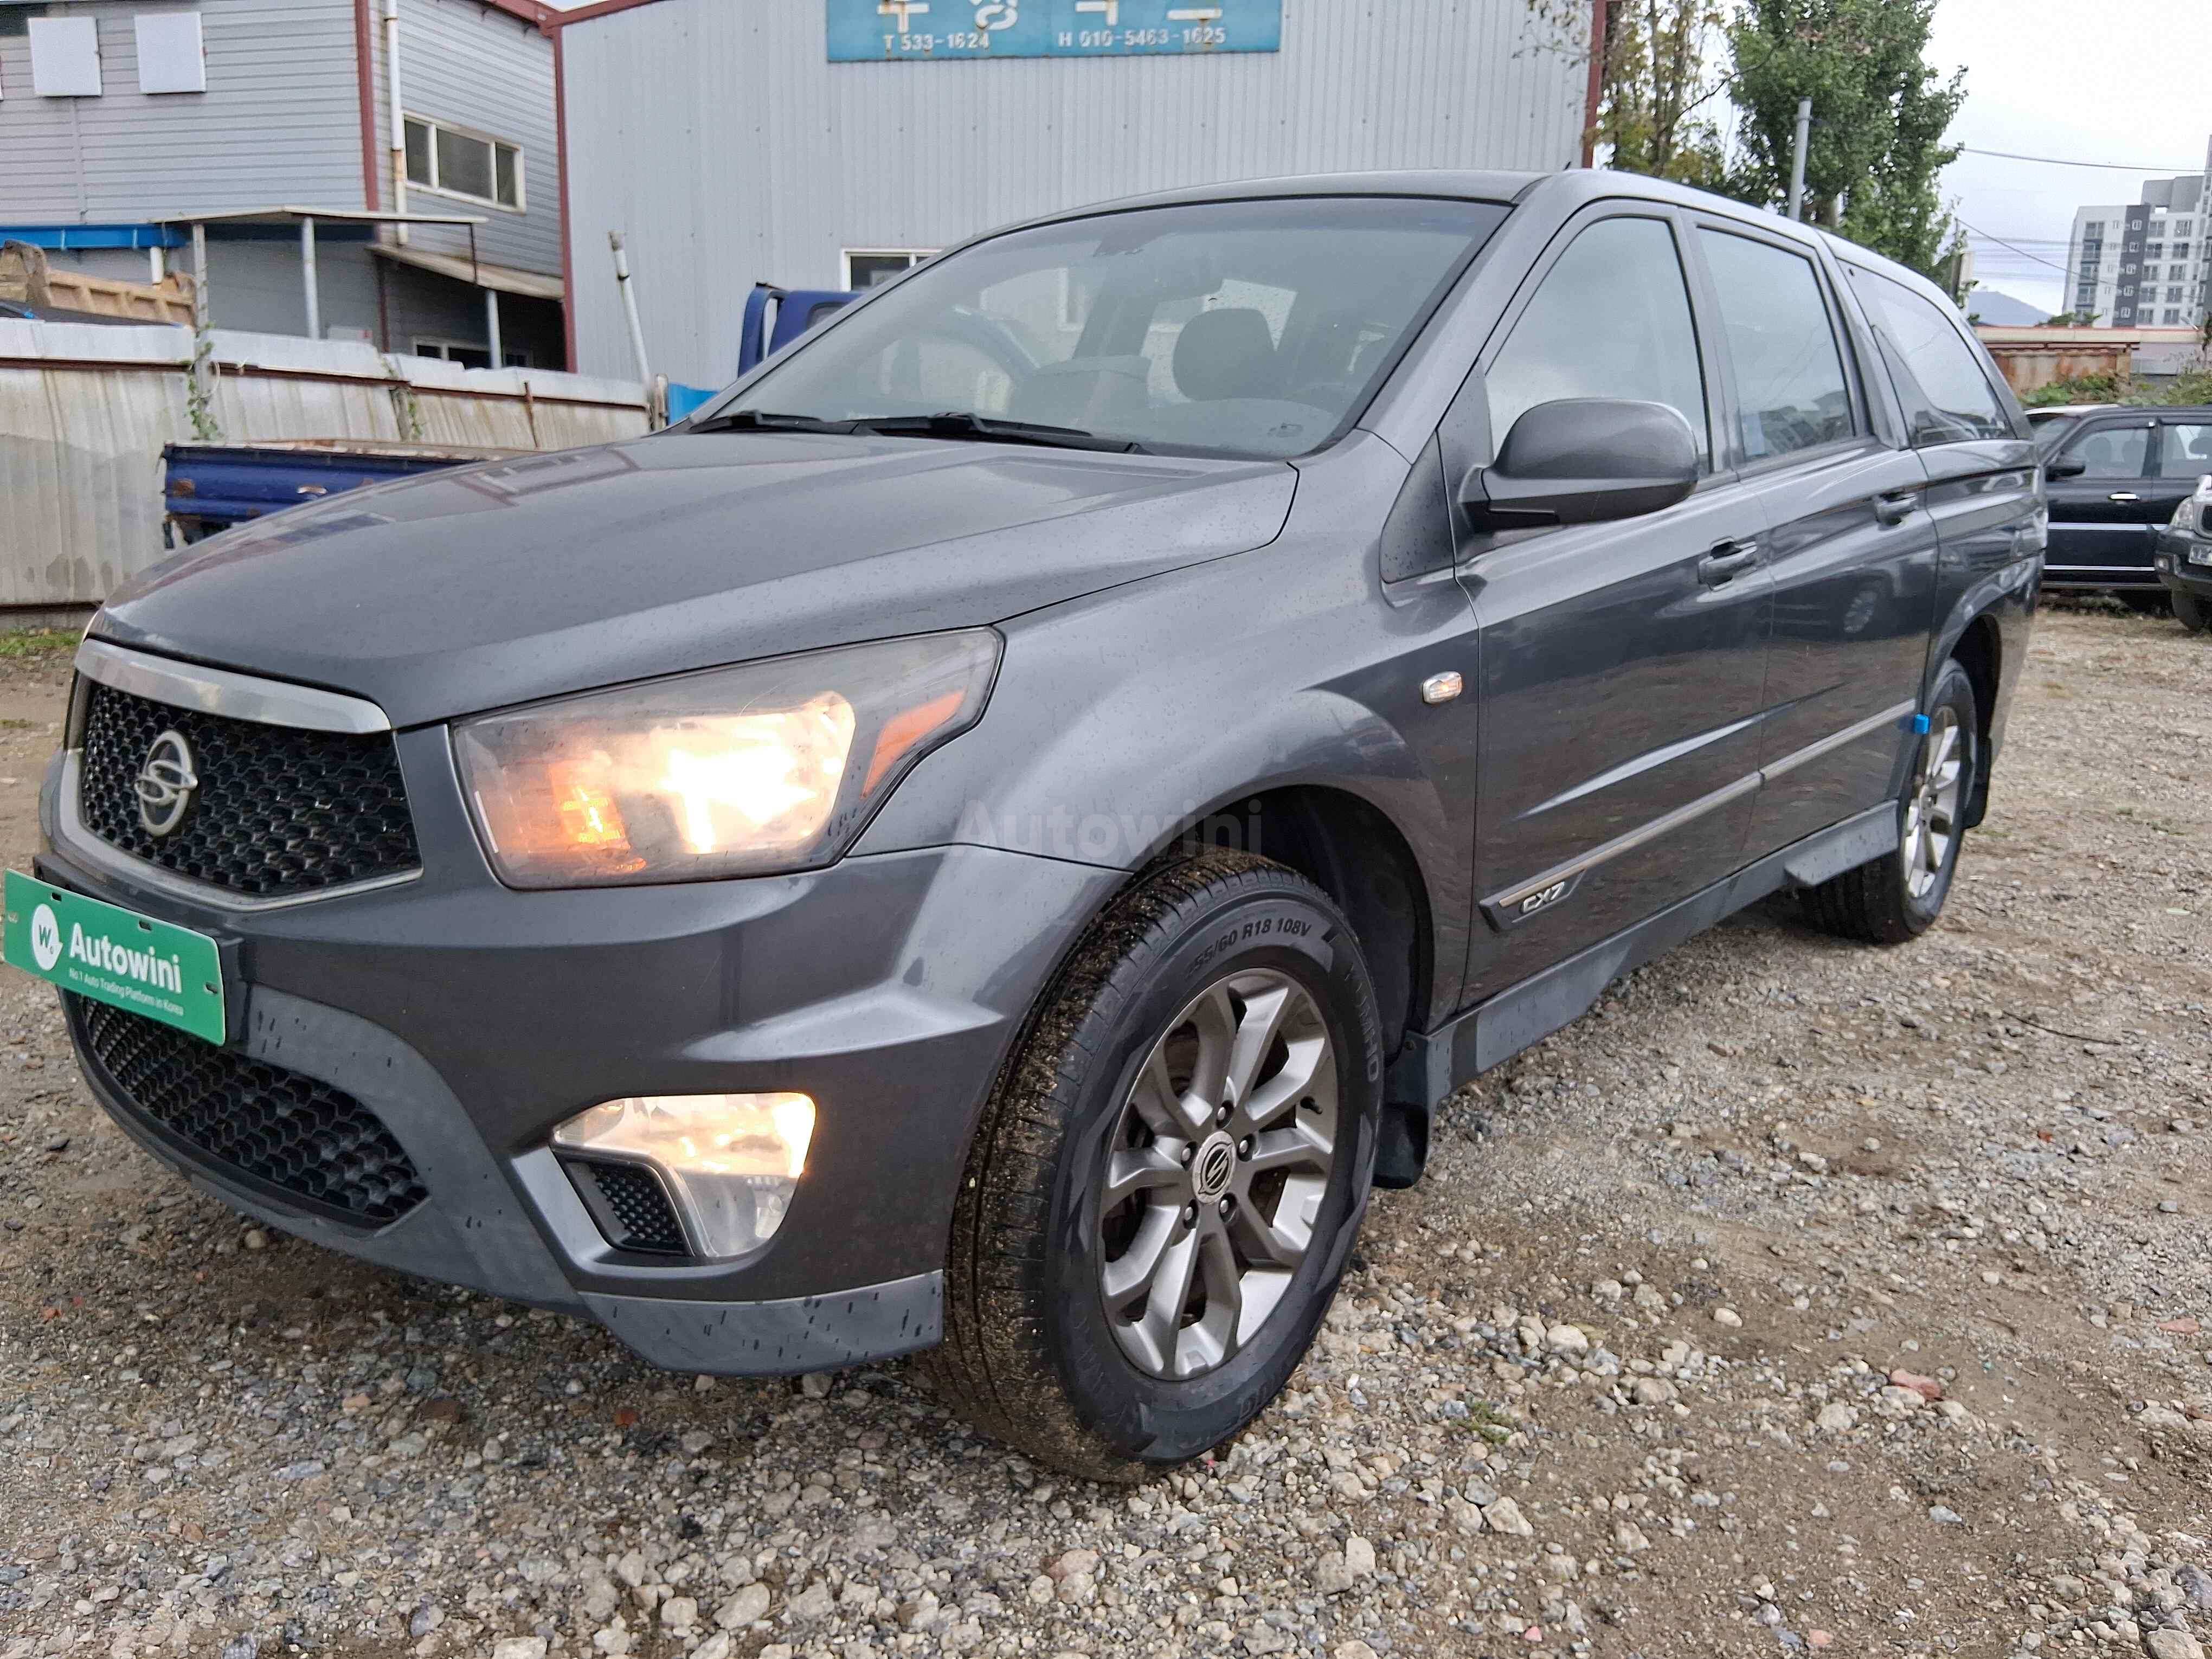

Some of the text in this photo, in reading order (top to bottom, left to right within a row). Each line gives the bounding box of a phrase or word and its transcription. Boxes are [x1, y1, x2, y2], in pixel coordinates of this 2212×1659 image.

[883, 34, 895, 50] T
[1058, 31, 1072, 47] H
[1523, 881, 1565, 913] CX7
[1242, 918, 1272, 940] R18
[1277, 918, 1312, 936] 108V
[69, 922, 182, 994] Autowini
